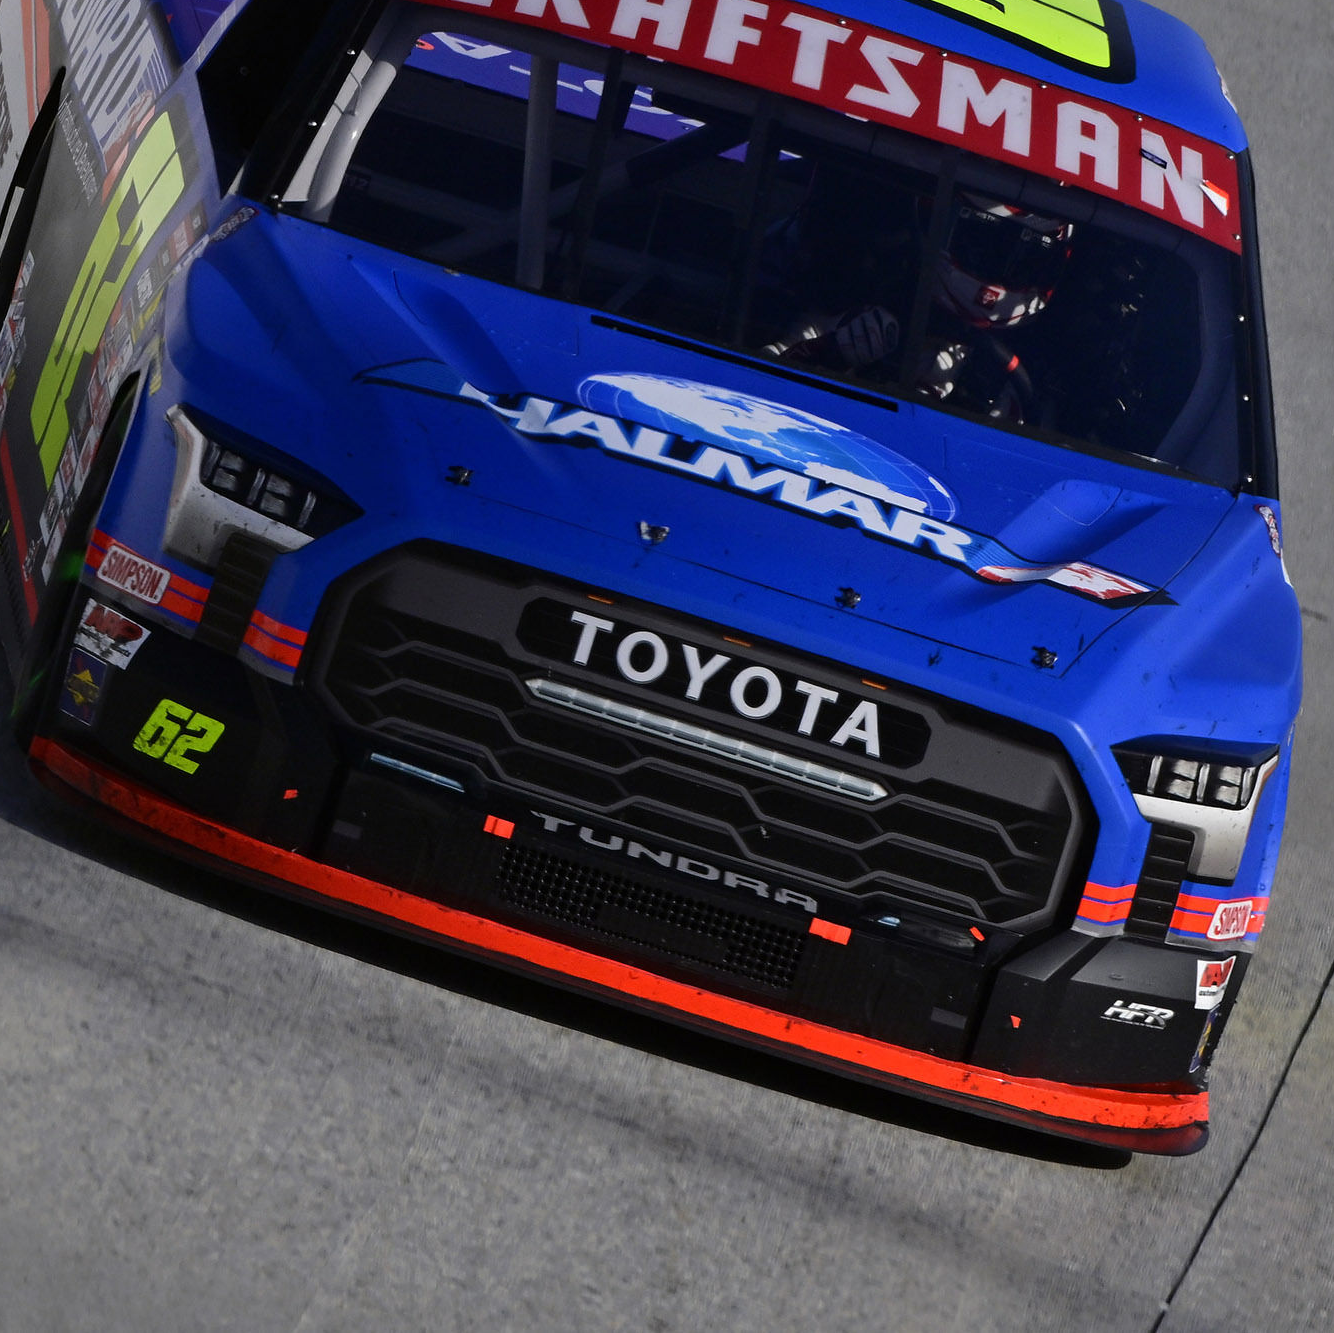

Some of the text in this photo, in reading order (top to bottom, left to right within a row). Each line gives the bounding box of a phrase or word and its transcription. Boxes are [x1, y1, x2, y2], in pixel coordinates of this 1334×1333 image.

[465, 388, 971, 562] HALMAR
[102, 550, 164, 599] SIMPSON
[570, 611, 883, 759] TOYOTA
[133, 699, 225, 775] 62
[530, 809, 819, 914] TUNDRA
[1214, 904, 1251, 936] SIMPSON
